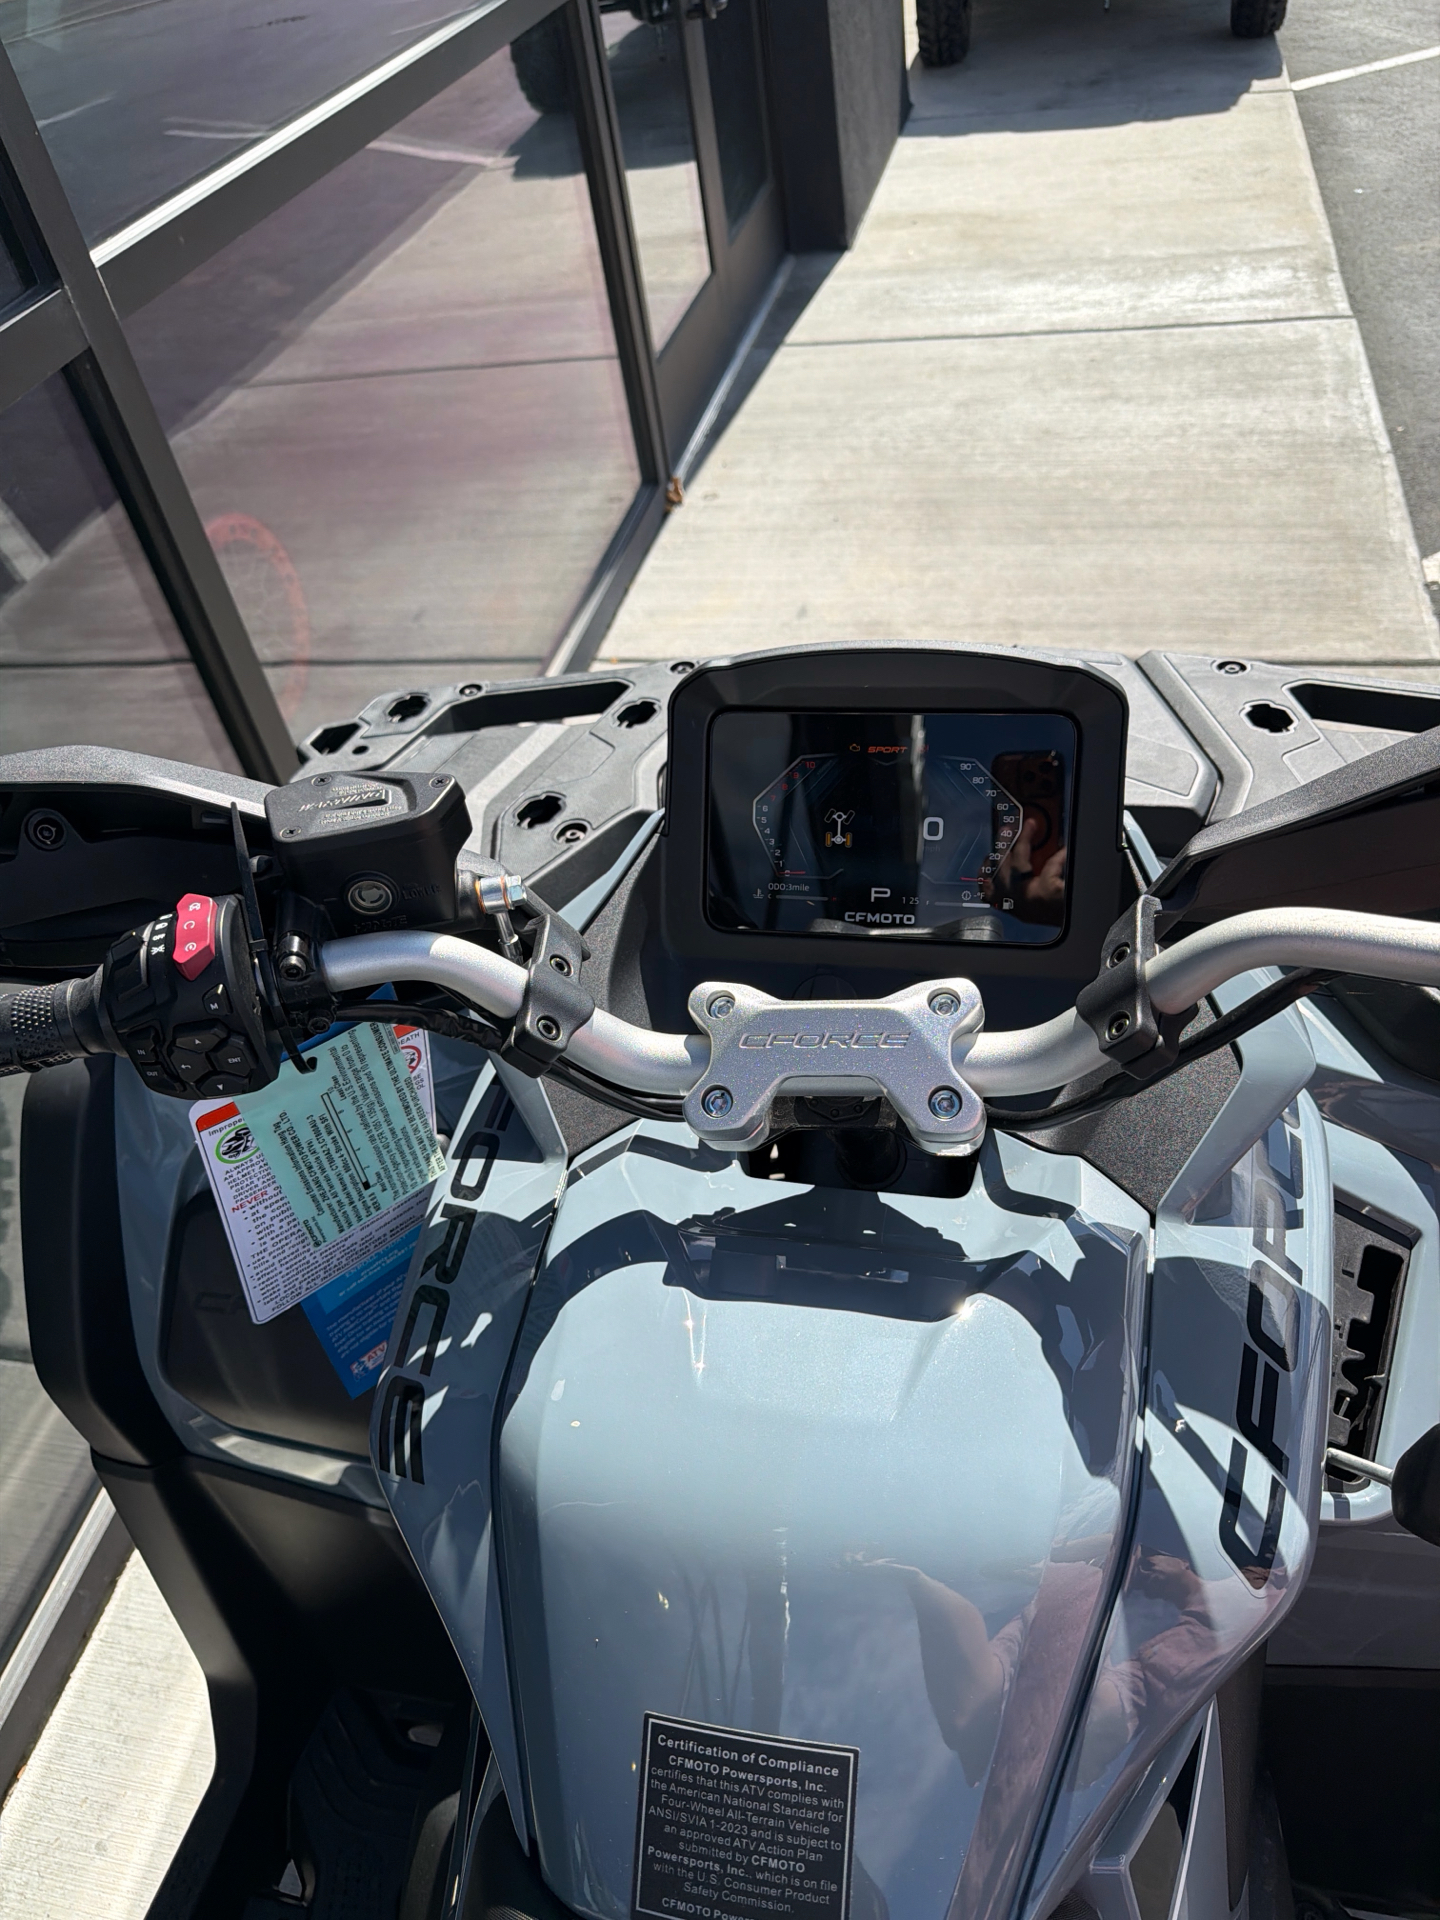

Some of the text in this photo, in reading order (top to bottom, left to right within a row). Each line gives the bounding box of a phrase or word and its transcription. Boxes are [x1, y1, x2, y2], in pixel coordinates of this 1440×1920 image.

[868, 746, 908, 754] SPORT
[960, 763, 972, 771] 90
[997, 803, 1009, 811] 60
[995, 841, 1007, 849] 30
[870, 887, 891, 903] P
[844, 911, 916, 925] CFMOTO
[152, 933, 166, 941] OFF
[209, 1003, 219, 1011] M
[347, 1028, 367, 1064] representing
[369, 1021, 387, 1051] CONSUMER
[738, 1031, 912, 1049] CFORCE
[227, 1056, 242, 1064] ENT
[345, 1054, 356, 1069] from
[380, 1049, 397, 1076] ULTIMATE
[331, 1074, 341, 1089] Clean
[362, 1070, 374, 1082] and
[390, 1074, 400, 1086] THE
[369, 1080, 385, 1107] emissions
[272, 1120, 282, 1133] Tag
[318, 1112, 334, 1136] With SFI
[277, 1129, 288, 1146] Hang
[290, 1133, 306, 1156] POWER
[305, 1138, 319, 1155] (ATVs)
[225, 1157, 253, 1175] ALWAYS
[284, 1143, 302, 1172] Information
[300, 1153, 317, 1177] CFMOTO
[314, 1155, 327, 1175] Vehicle
[223, 1173, 233, 1182] AN
[227, 1168, 255, 1185] HELMET
[232, 1174, 276, 1199] DRIVER AND
[234, 1171, 271, 1192] GEAR FOR
[234, 1179, 277, 1204] PASSENGER
[311, 1175, 330, 1202] ZHEJIANG
[231, 1189, 268, 1213] NEVER
[248, 1188, 283, 1210] without
[250, 1208, 260, 1217] at
[252, 1213, 267, 1223] the
[254, 1220, 266, 1229] on
[255, 1223, 274, 1235] with
[257, 1229, 275, 1241] with
[250, 1246, 268, 1259] THE
[657, 1734, 839, 1776] Certification of Compliance
[668, 1754, 826, 1792] CFMOTO Powersports, Inc.
[650, 1766, 844, 1809] certifies that this ATV complies with
[650, 1778, 843, 1822] the American National Standard for
[661, 1793, 830, 1835] Four-Wheel All-Terrain Vehicle
[648, 1805, 841, 1850] ANSI/SVIA 1-2023 and is subject to
[663, 1824, 823, 1861] an approved ATV Action Plan
[678, 1841, 805, 1873] submitted by CFMOTO
[647, 1845, 723, 1873] Powersports,
[755, 1870, 788, 1884] which
[790, 1875, 800, 1886] is
[802, 1879, 817, 1889] on
[820, 1879, 837, 1892] file
[653, 1862, 674, 1874] with
[676, 1867, 694, 1879] the
[723, 1876, 782, 1896] Consumer
[784, 1887, 829, 1904] Product
[661, 1897, 711, 1917] CFMOTO
[683, 1881, 794, 1913] Safety Commission.
